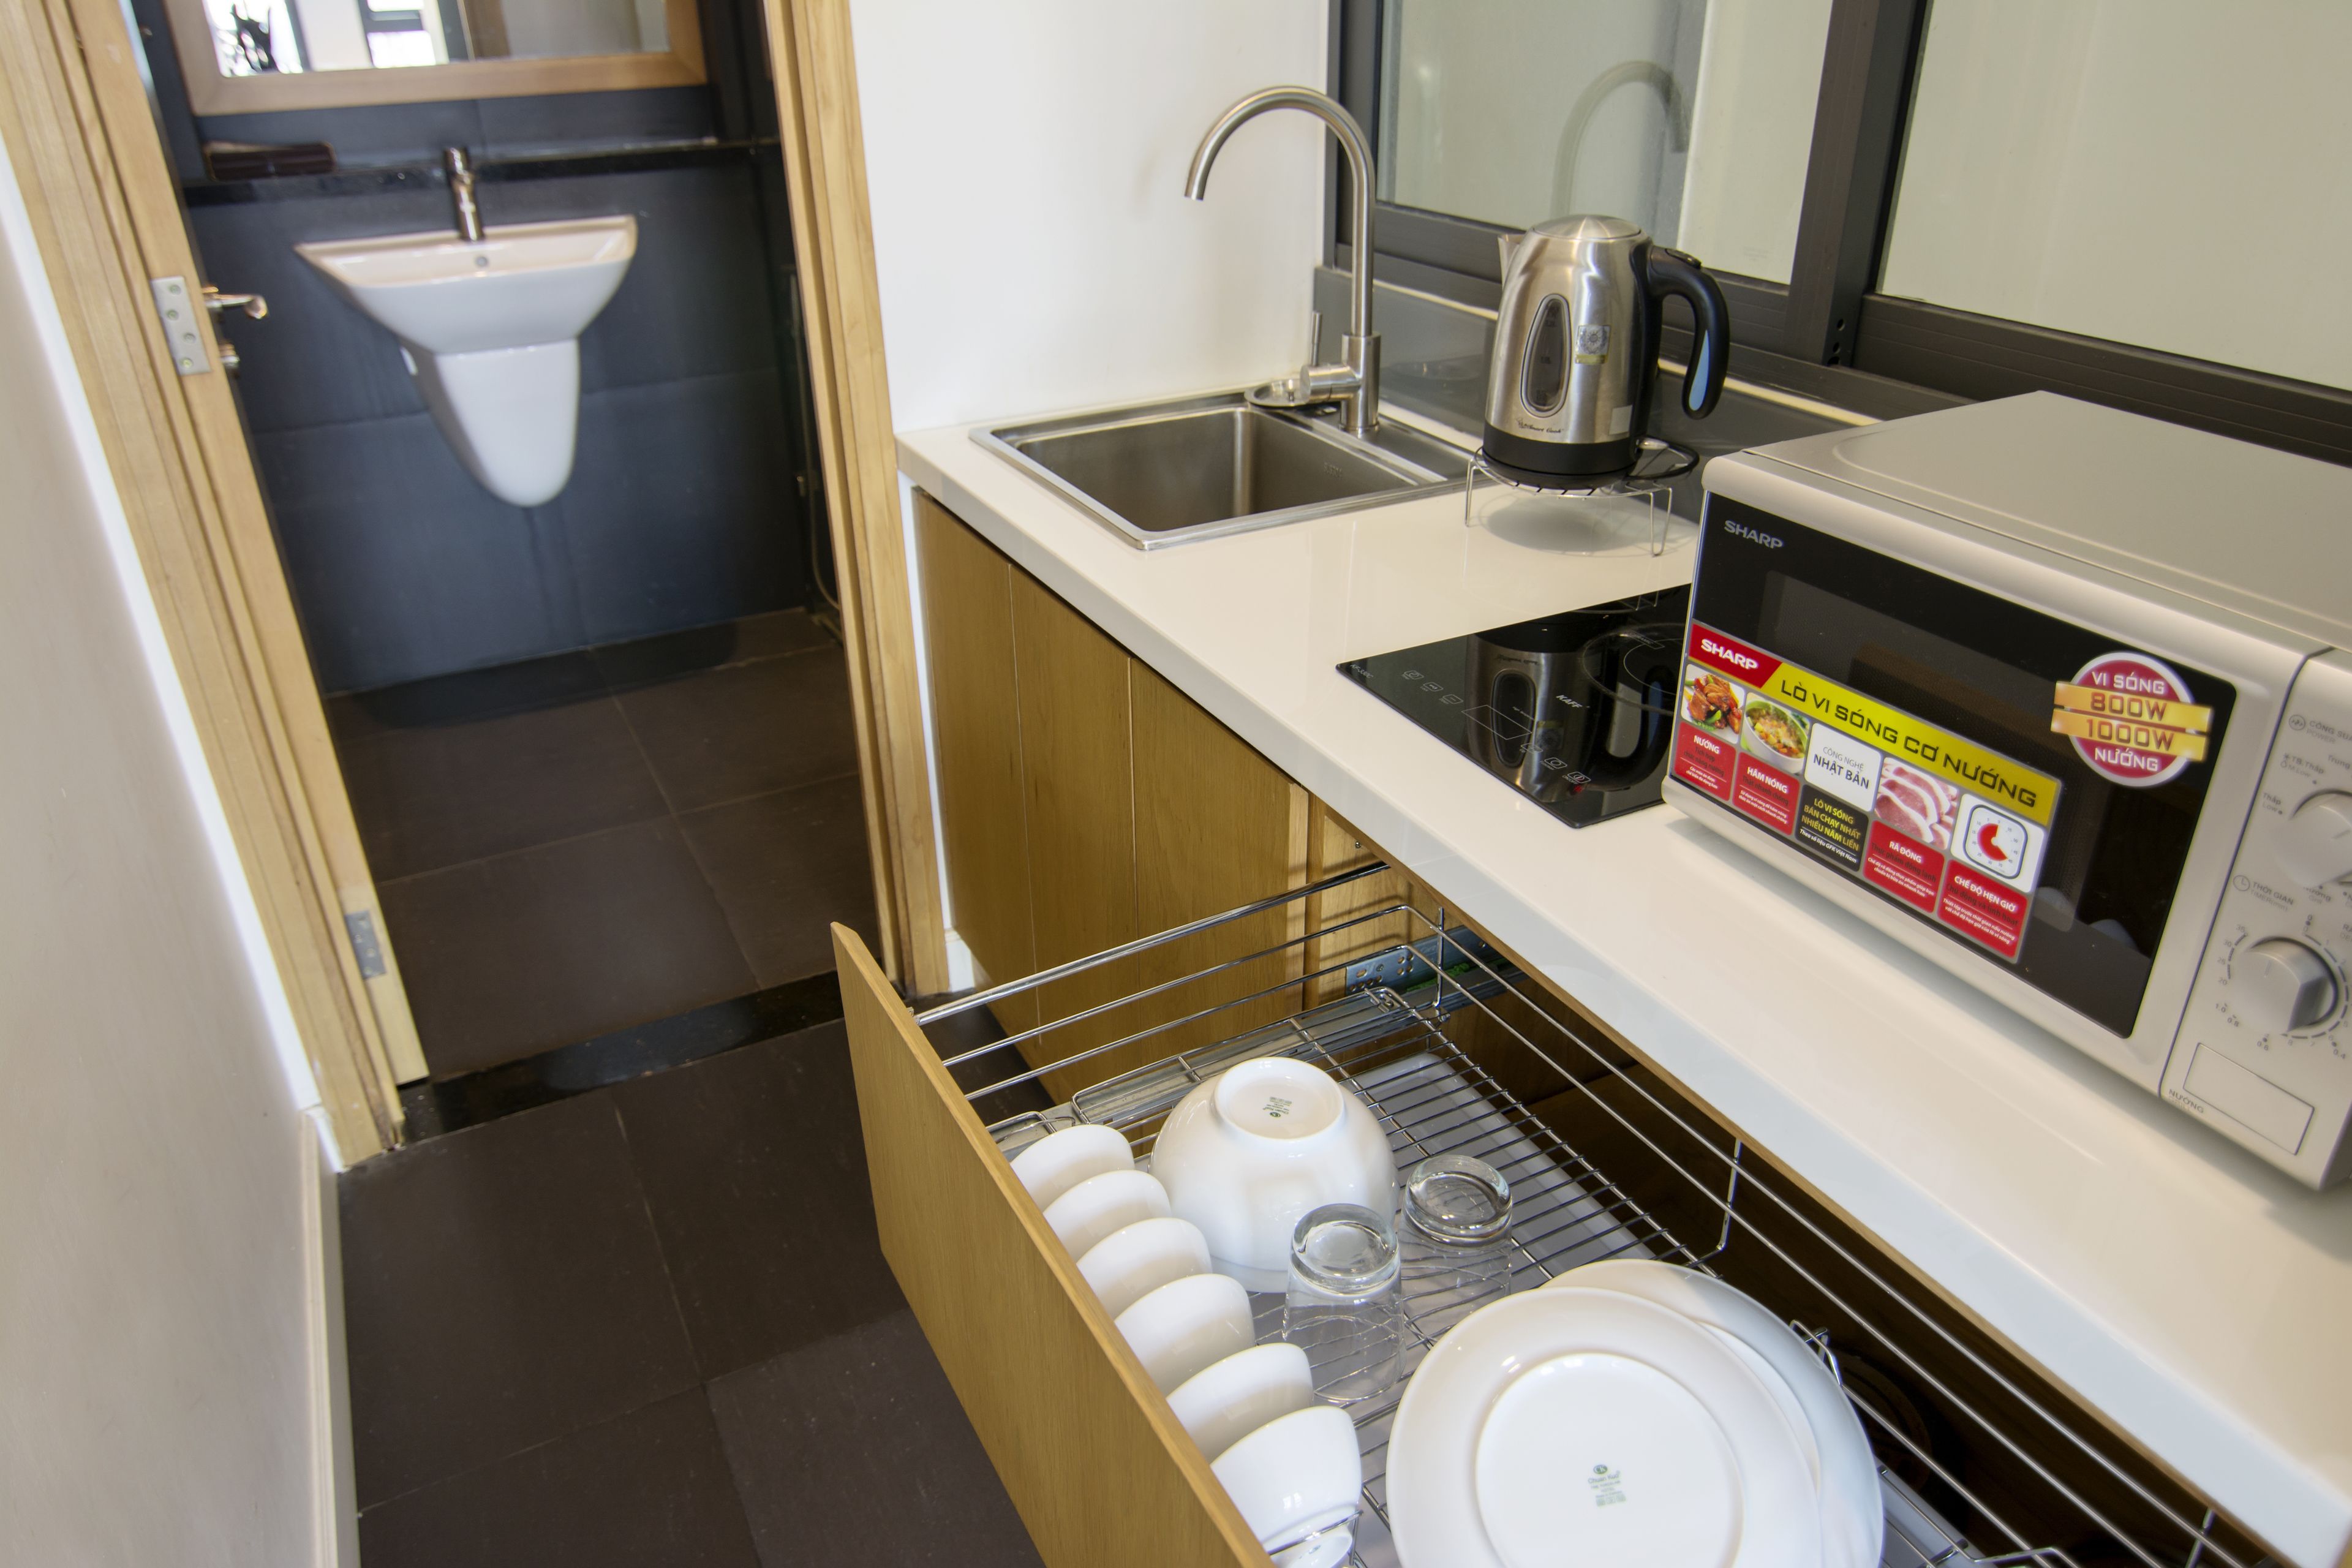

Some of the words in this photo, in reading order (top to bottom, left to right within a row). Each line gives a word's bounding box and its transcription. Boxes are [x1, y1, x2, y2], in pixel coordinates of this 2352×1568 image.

[1724, 520, 1784, 549] SHARP
[1701, 638, 1758, 669] SHARP
[2092, 671, 2106, 686] VI
[2113, 672, 2165, 695] SÓNG
[1556, 695, 1583, 708] KAFF
[2090, 692, 2167, 721] 800W
[2086, 718, 2174, 751] 1000W
[2306, 728, 2337, 744] POWER
[2309, 720, 2335, 735] CÔNG
[1694, 735, 1719, 754] NƯỚNG
[1781, 679, 1807, 703] LÒ
[1812, 693, 1830, 713] VI
[1834, 704, 1898, 744] SÓNG
[1904, 736, 1939, 762] CƠ
[1943, 753, 2037, 808] NƯỚNG
[1813, 754, 1844, 775] NHẬT
[1845, 769, 1869, 789] BẢN
[1823, 747, 1842, 761] CÔNG
[1844, 756, 1864, 772] NGHỆ
[2095, 747, 2158, 772] NƯỚNG
[2328, 754, 2351, 770] Trung
[1747, 767, 1764, 782] HÂM
[1765, 776, 1787, 794] NÓNG
[1804, 805, 1819, 818] BÁN
[1820, 814, 1839, 829] CHẠY
[1840, 824, 1861, 839] NHẤT
[1814, 798, 1823, 808] LÒ
[1825, 804, 1832, 813] VI
[1832, 808, 1853, 824] SÓNG
[1800, 829, 1811, 838] Theo
[1817, 837, 1826, 846] liệu
[1836, 848, 1845, 857] Việt
[1845, 854, 1856, 863] Nam
[1801, 815, 1823, 832] NHIỀU
[1824, 827, 1842, 842] NĂM
[1842, 837, 1859, 851] LIỀN
[1889, 841, 1899, 852] RÃ
[1900, 847, 1921, 864] ĐÔNG
[1954, 876, 1970, 889] CHẾ
[1970, 884, 1982, 896] ĐỘ
[1983, 891, 2000, 905] HẸN
[2000, 900, 2016, 912] GIỜ
[2274, 892, 2294, 905] GIAN
